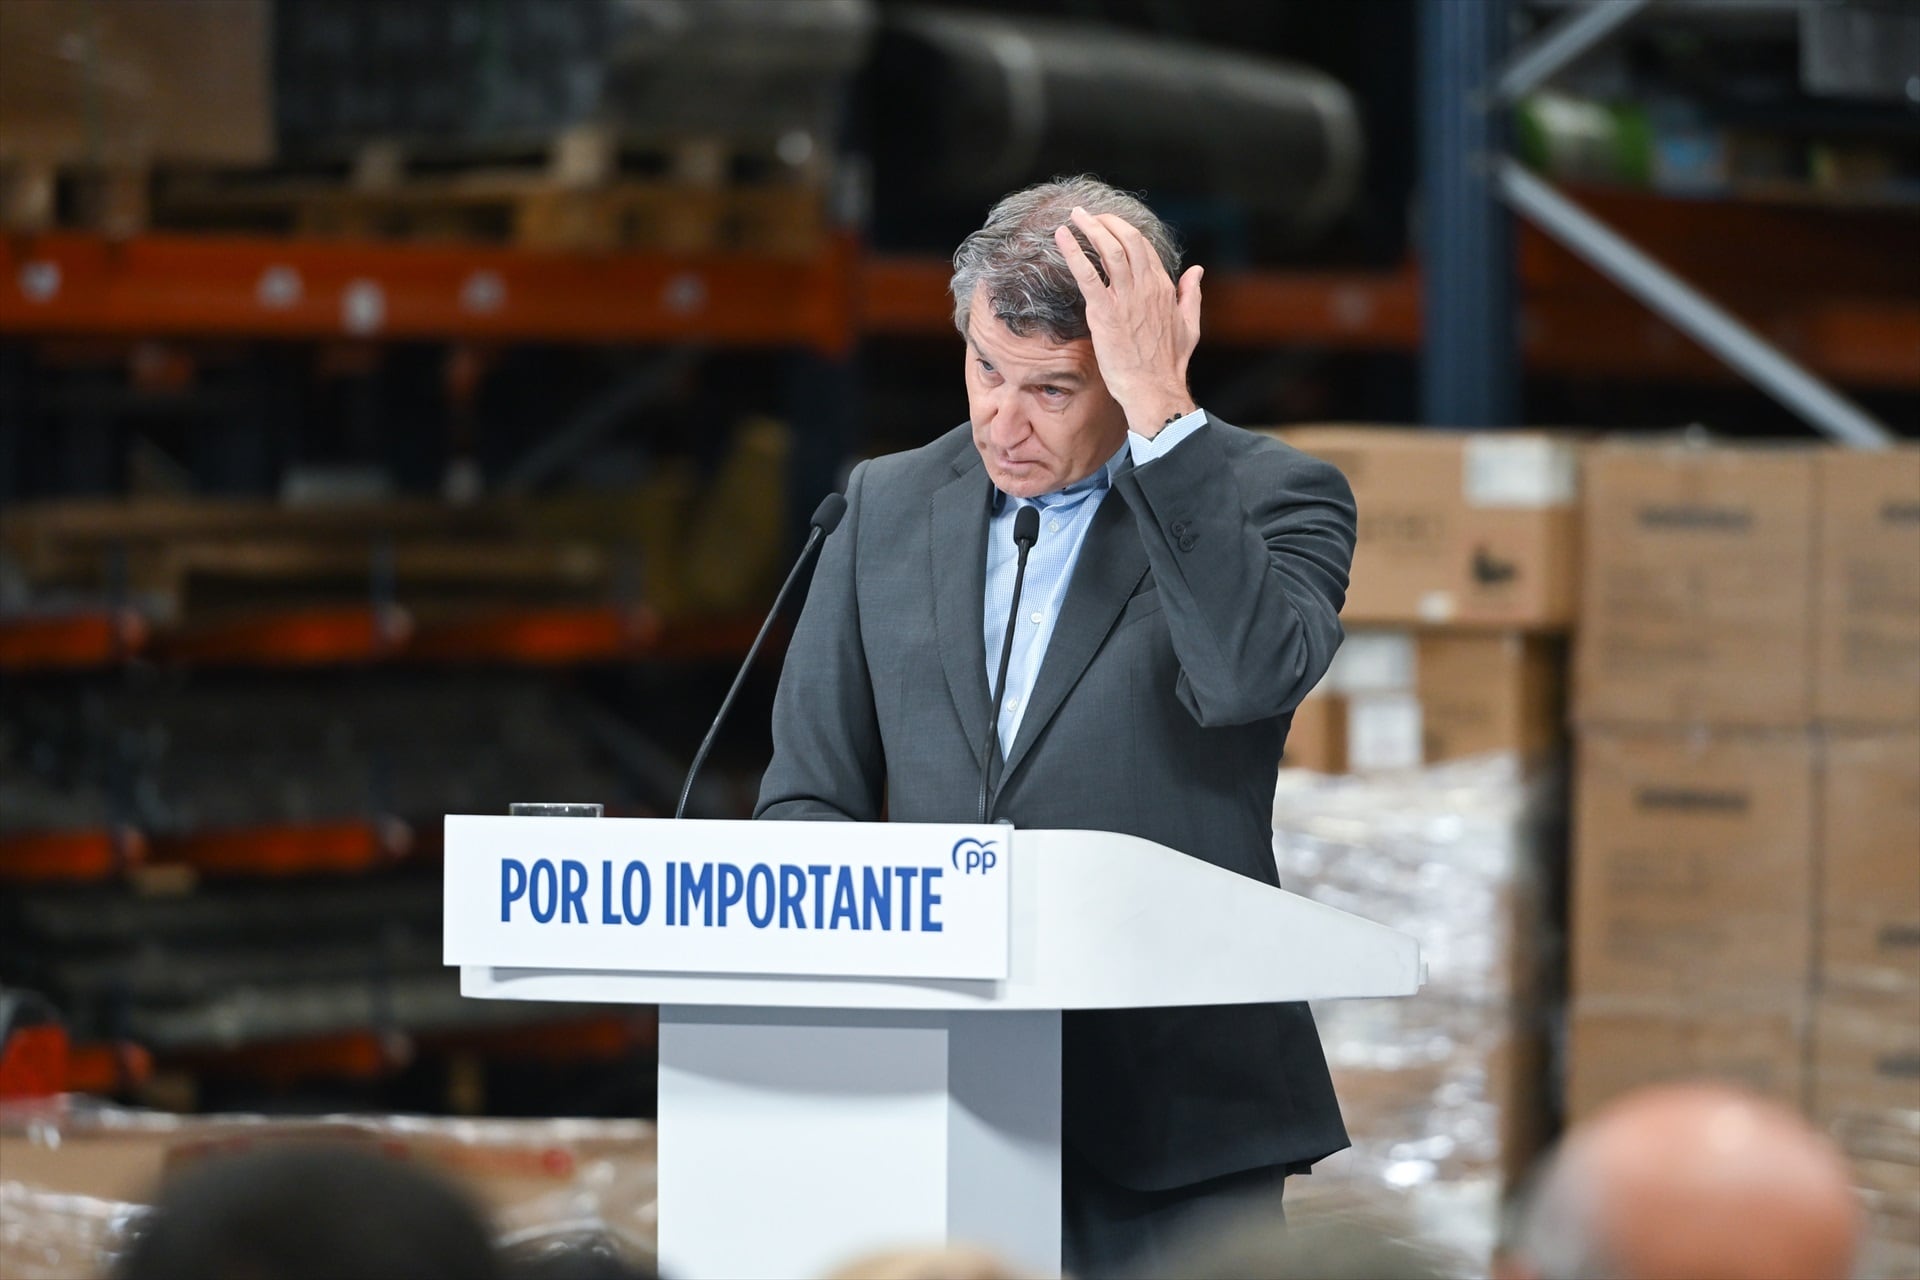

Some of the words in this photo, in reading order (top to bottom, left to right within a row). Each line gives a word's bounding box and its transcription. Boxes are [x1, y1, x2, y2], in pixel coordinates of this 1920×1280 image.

[500, 857, 590, 925] POR
[601, 859, 652, 927] LO
[664, 860, 944, 933] IMPORTANTE
